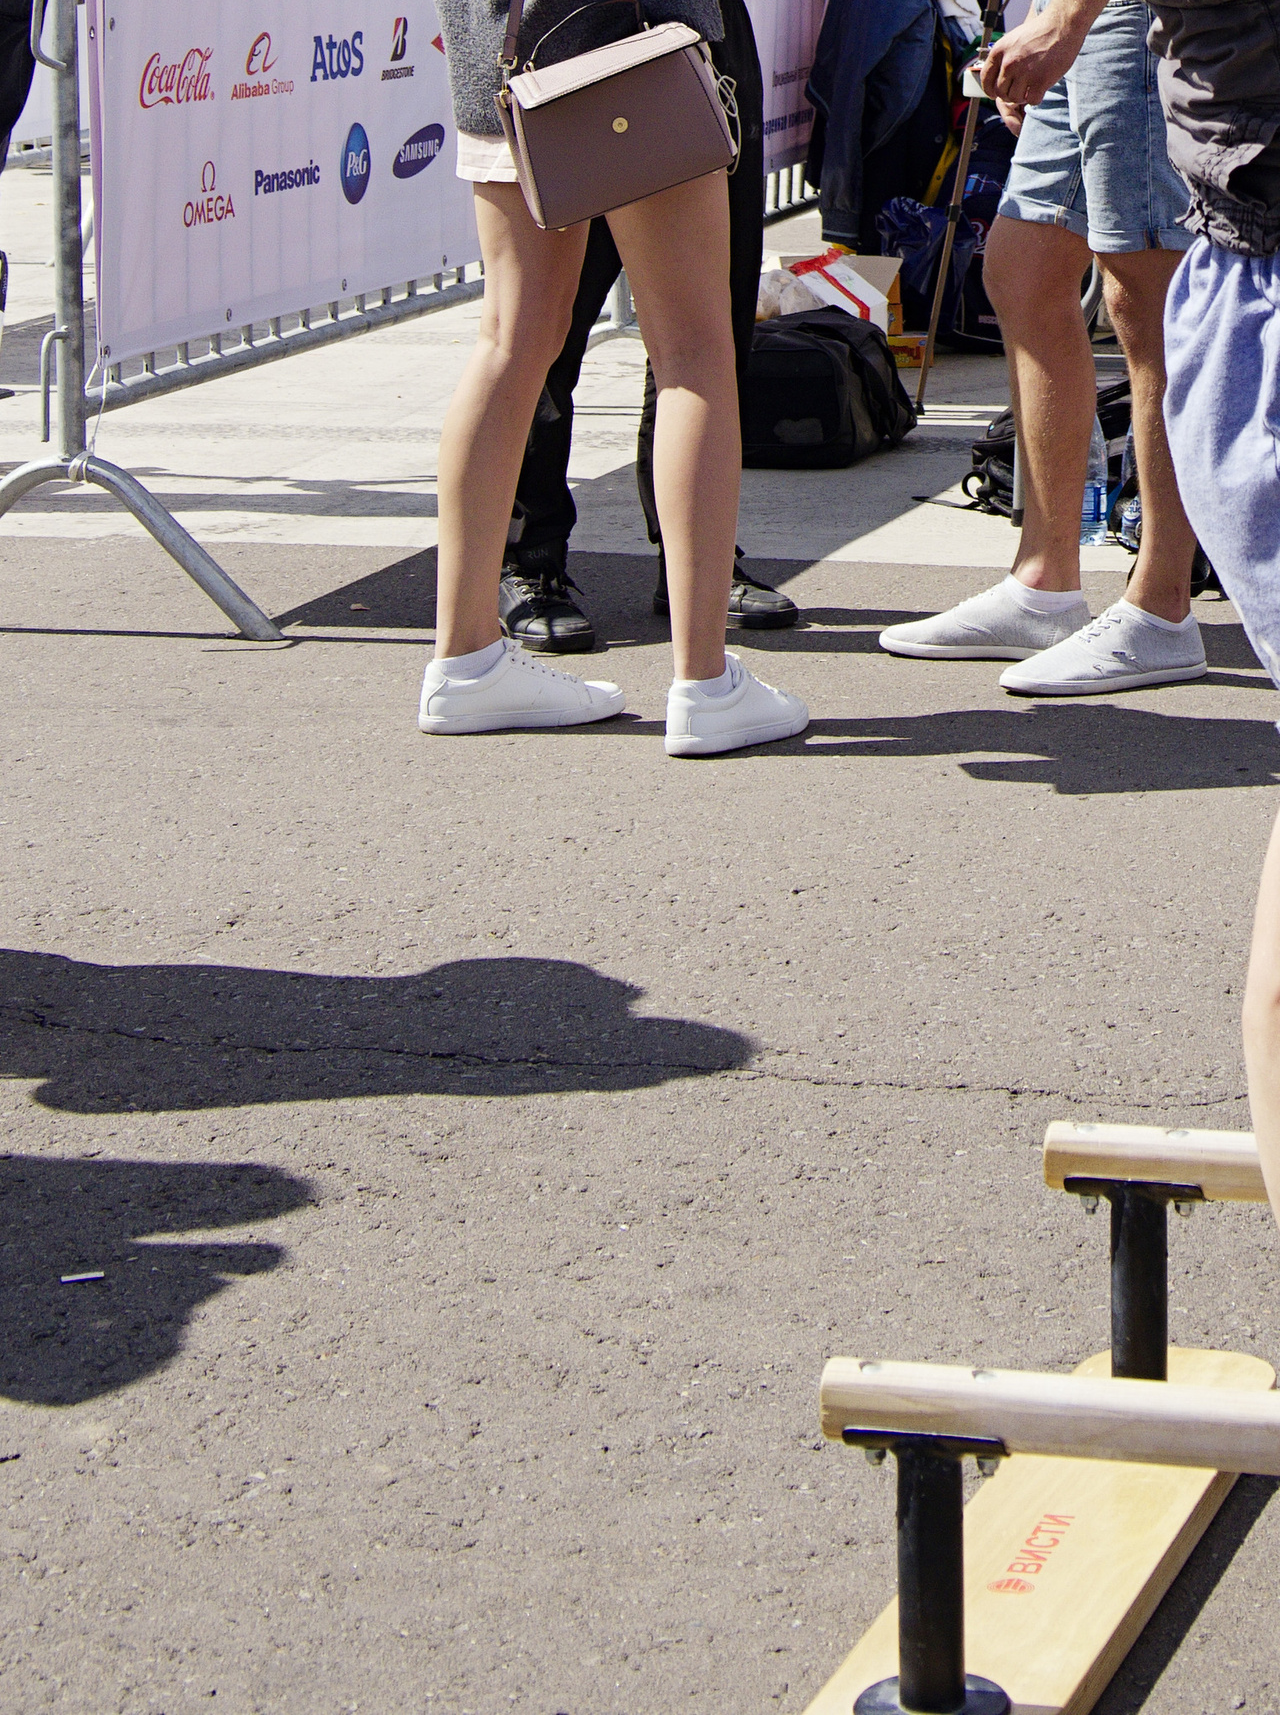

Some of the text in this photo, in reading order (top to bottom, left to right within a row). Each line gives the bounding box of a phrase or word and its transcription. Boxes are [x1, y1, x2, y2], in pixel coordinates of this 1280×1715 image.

[310, 30, 364, 82] Atos
[231, 78, 295, 101] Alibaba Group
[345, 148, 369, 178] P&G
[399, 137, 441, 164] SAMSUNG
[254, 159, 321, 196] Panasonic
[183, 193, 236, 228] OMEGA
[1006, 1513, 1076, 1575] ВИСТИ
